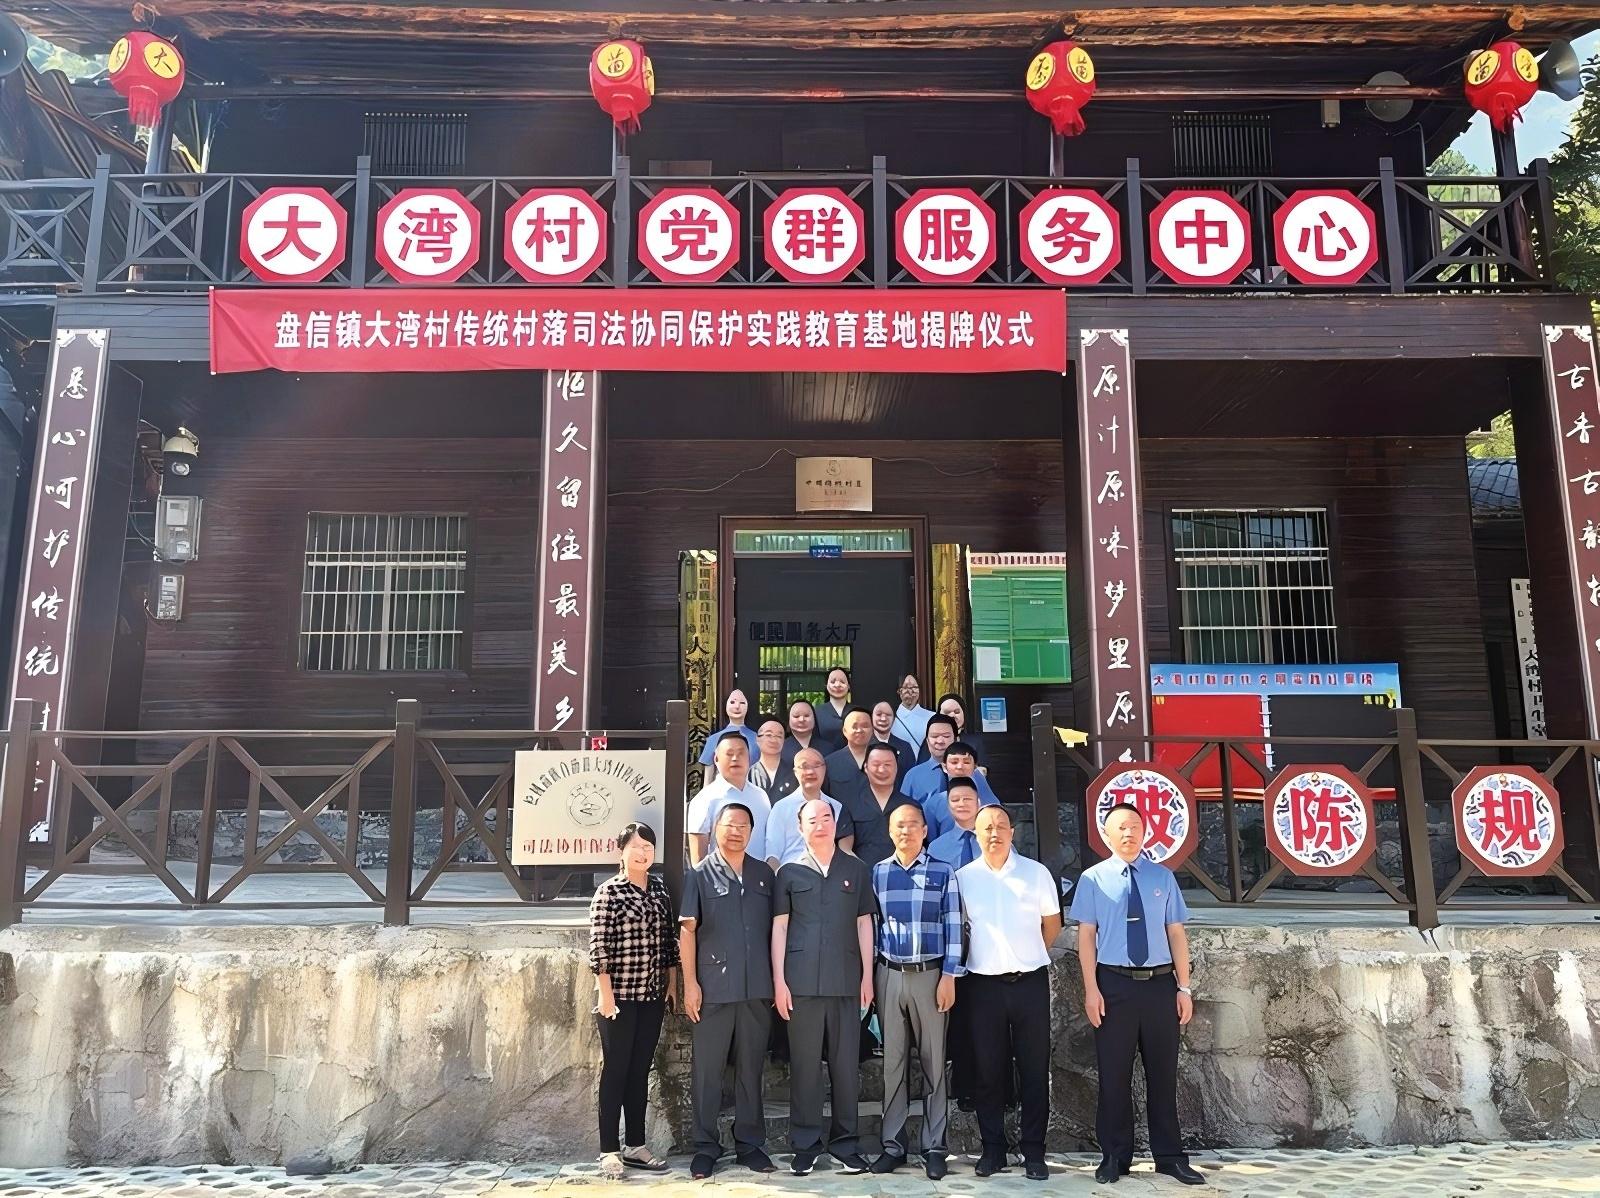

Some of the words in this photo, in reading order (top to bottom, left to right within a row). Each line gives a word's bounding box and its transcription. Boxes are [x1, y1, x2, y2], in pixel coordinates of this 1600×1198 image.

[261, 205, 1358, 265] 大湾村党群服务中心
[274, 309, 1036, 350] 盘信镇大湾村传统村落司法协同保护实践教育基地揭牌仪式
